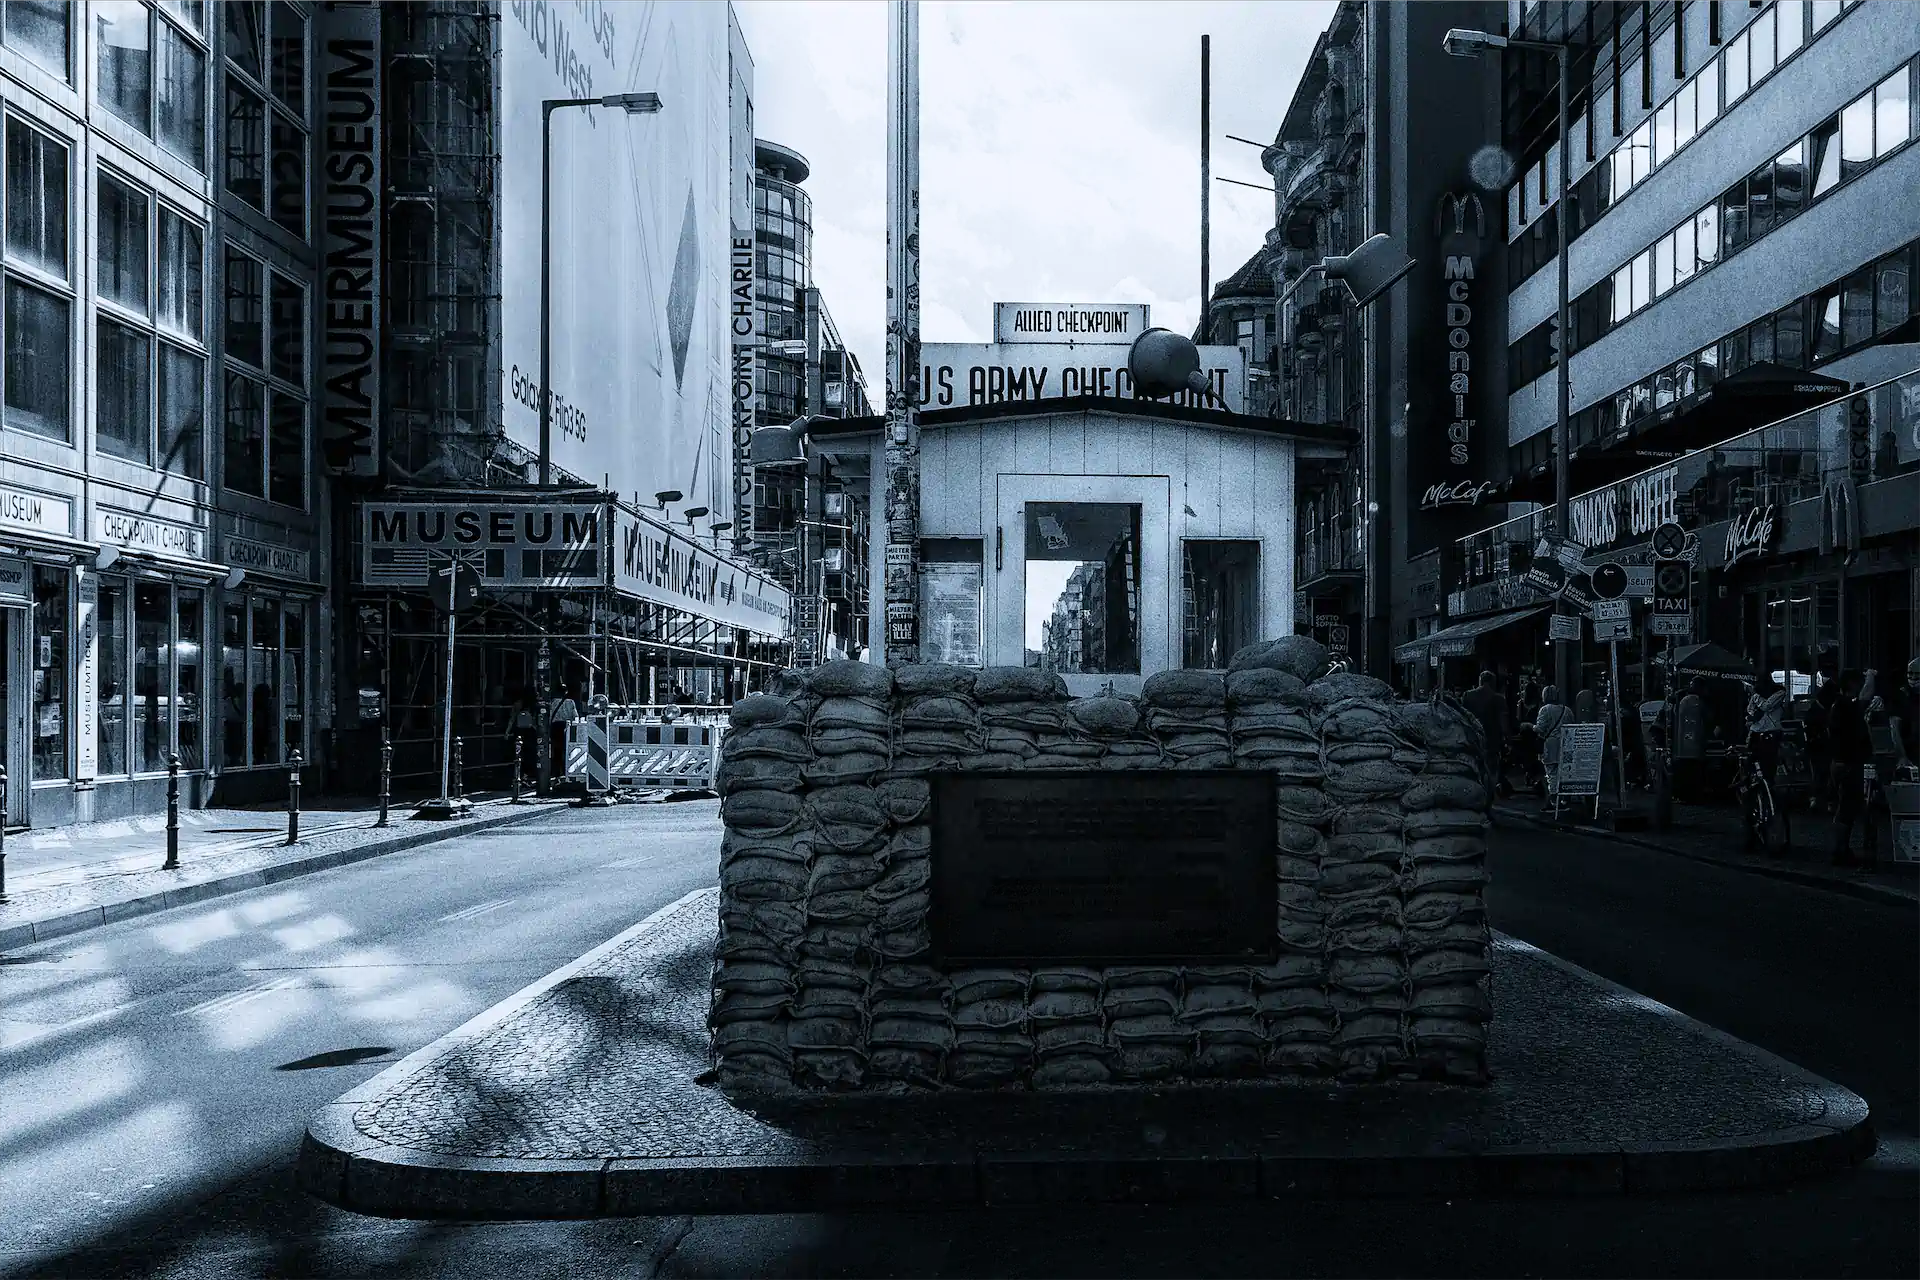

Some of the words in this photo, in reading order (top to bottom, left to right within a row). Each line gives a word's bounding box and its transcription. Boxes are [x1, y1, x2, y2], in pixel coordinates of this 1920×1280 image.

[325, 40, 375, 456] MAUERMUSEUM
[732, 237, 753, 336] CHARLIE
[1014, 309, 1053, 334] ALLIED
[1056, 309, 1130, 334] CHECKPOINT
[511, 364, 542, 413] Galax
[555, 393, 574, 442] Flip3
[574, 408, 587, 444] 5G
[920, 365, 954, 406] US
[969, 366, 1048, 405] ARMY
[733, 345, 752, 496] CHECKPOINT
[0, 492, 42, 525] USEUM
[1421, 479, 1492, 508] McCaf
[1573, 488, 1617, 548] SNACKS
[1630, 466, 1679, 536] COFFEE
[103, 515, 160, 549] CHECKPOINT
[162, 525, 197, 555] CHARLIE
[371, 510, 598, 544] MUSEUM
[1723, 504, 1776, 562] McCafé
[228, 540, 272, 569] CHECKPOINT
[273, 549, 301, 574] CHARLIE
[623, 525, 716, 608] MAUERMUSEUM
[1656, 597, 1688, 611] TAXI
